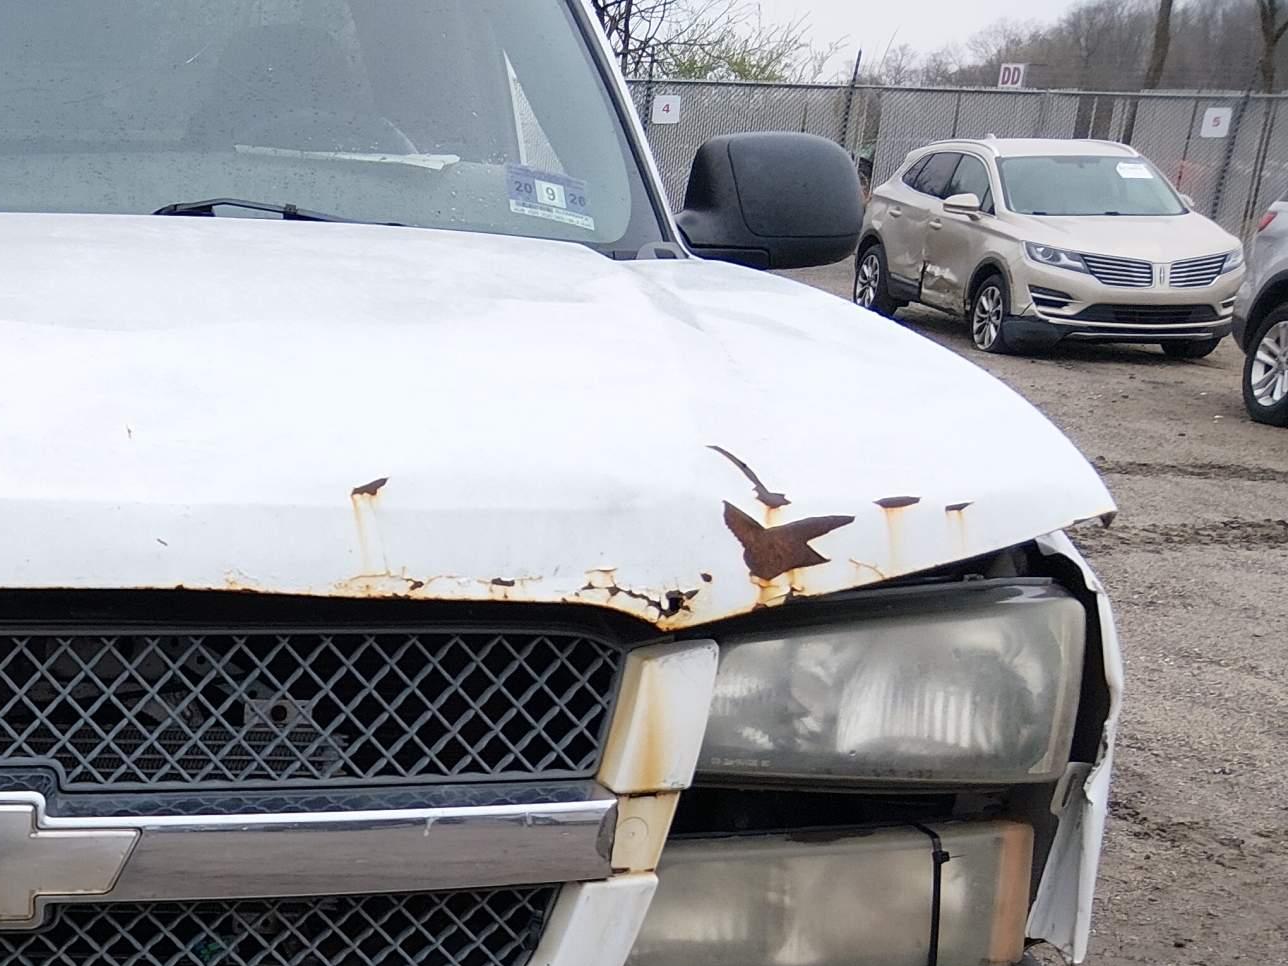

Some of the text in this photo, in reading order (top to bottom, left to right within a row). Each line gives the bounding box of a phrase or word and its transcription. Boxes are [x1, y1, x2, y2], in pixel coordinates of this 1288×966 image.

[1000, 66, 1022, 86] DD
[662, 103, 671, 114] 4
[1211, 116, 1222, 128] 5
[514, 181, 533, 194] 20
[546, 187, 556, 201] 9
